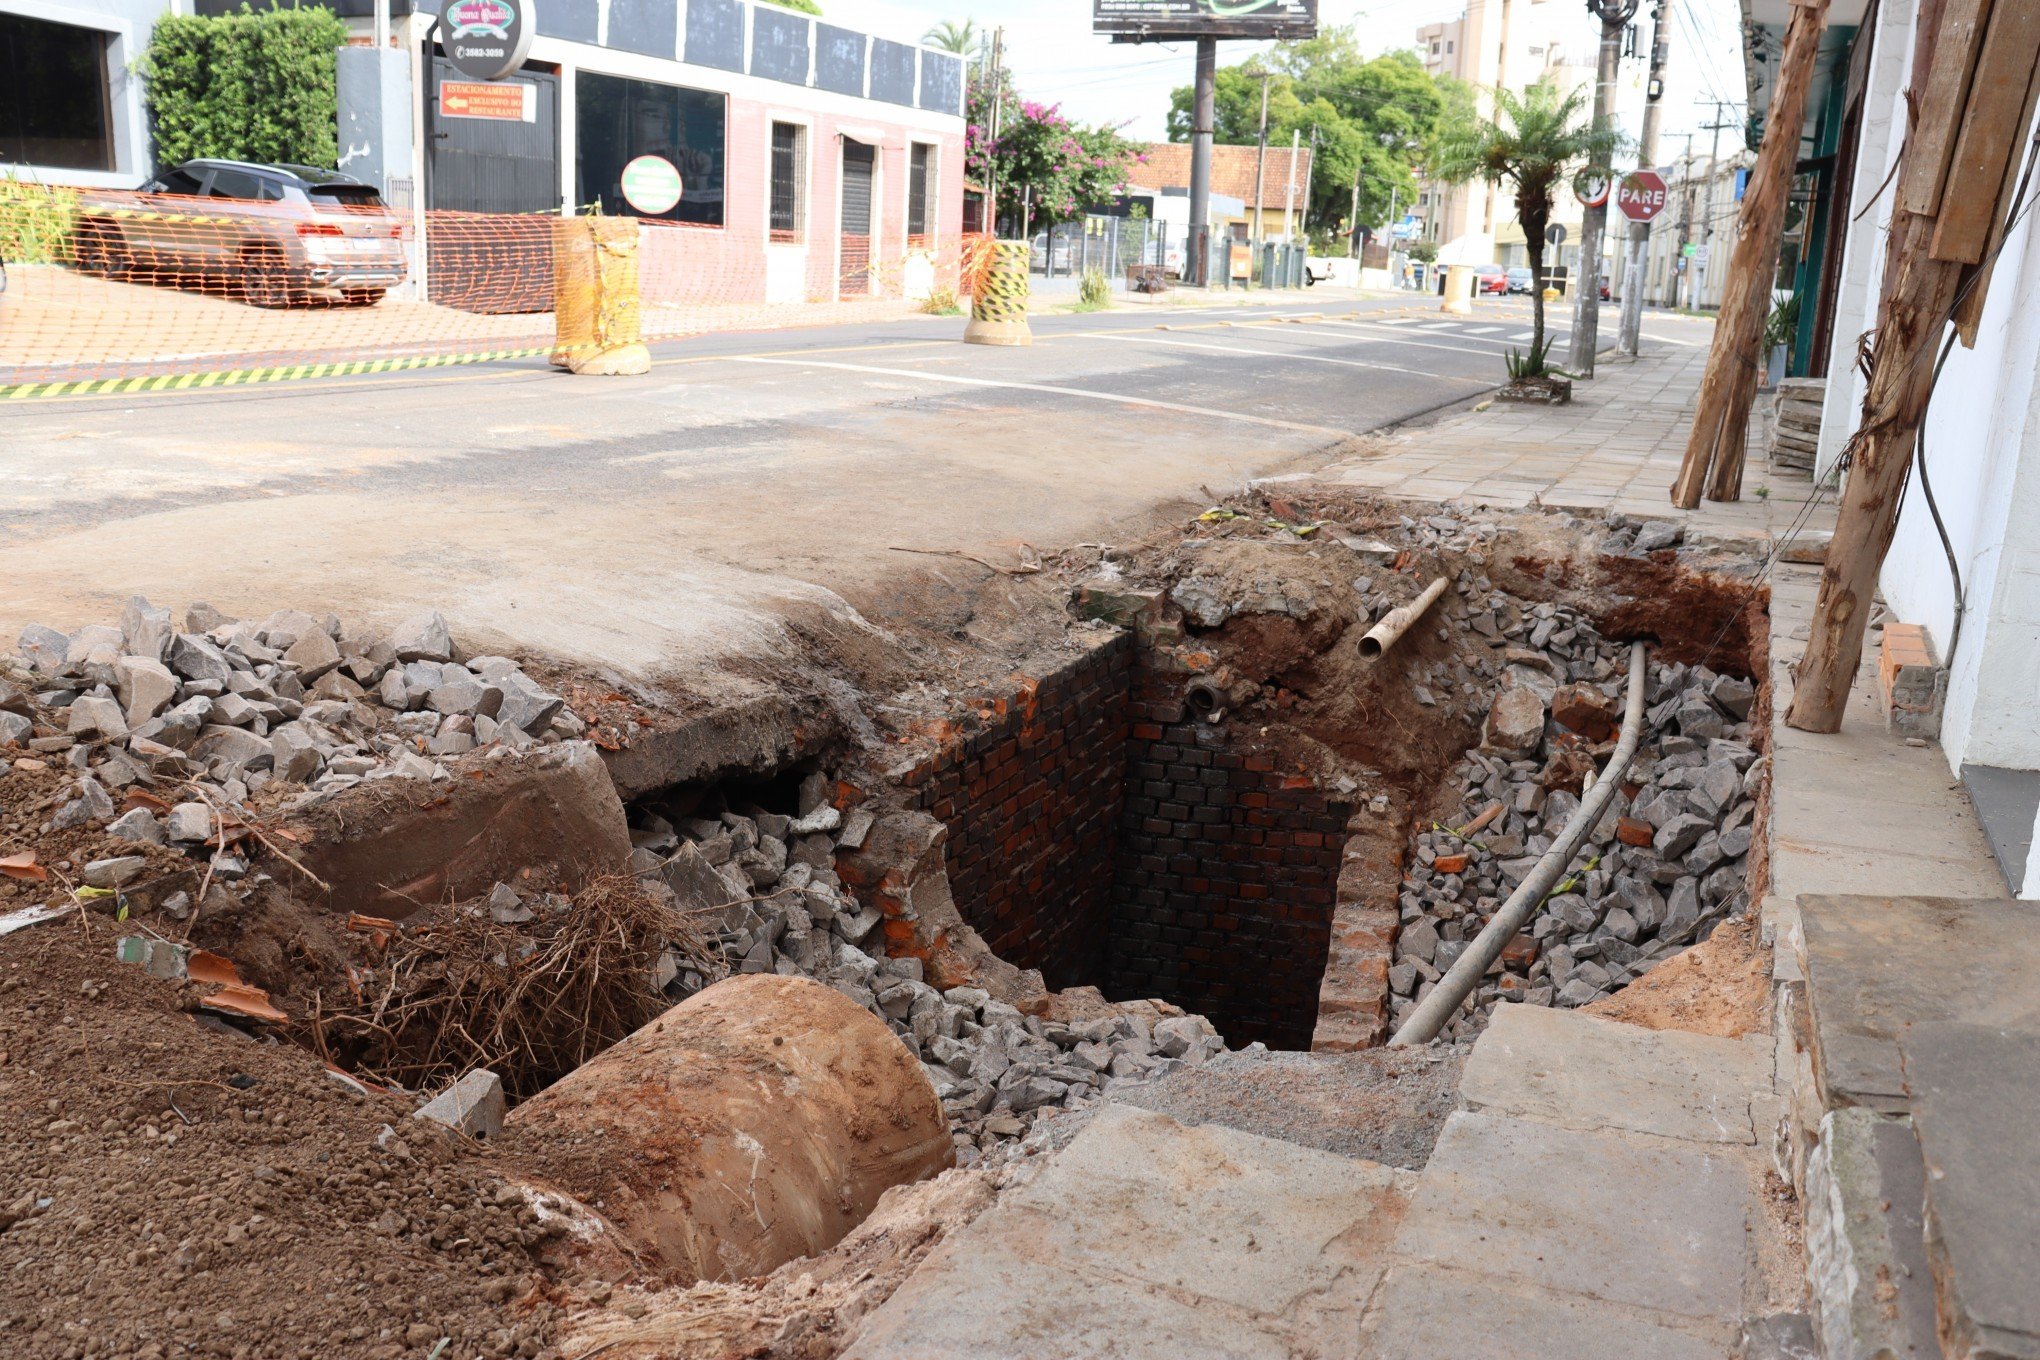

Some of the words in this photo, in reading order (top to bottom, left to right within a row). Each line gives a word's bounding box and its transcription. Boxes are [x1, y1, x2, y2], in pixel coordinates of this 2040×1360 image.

[447, 85, 521, 95] ESTACIONAMENTO
[469, 97, 509, 106] EXCLUSIVO
[511, 98, 521, 106] DO
[469, 107, 521, 116] RESTAURANTE
[1620, 188, 1663, 205] PARE
